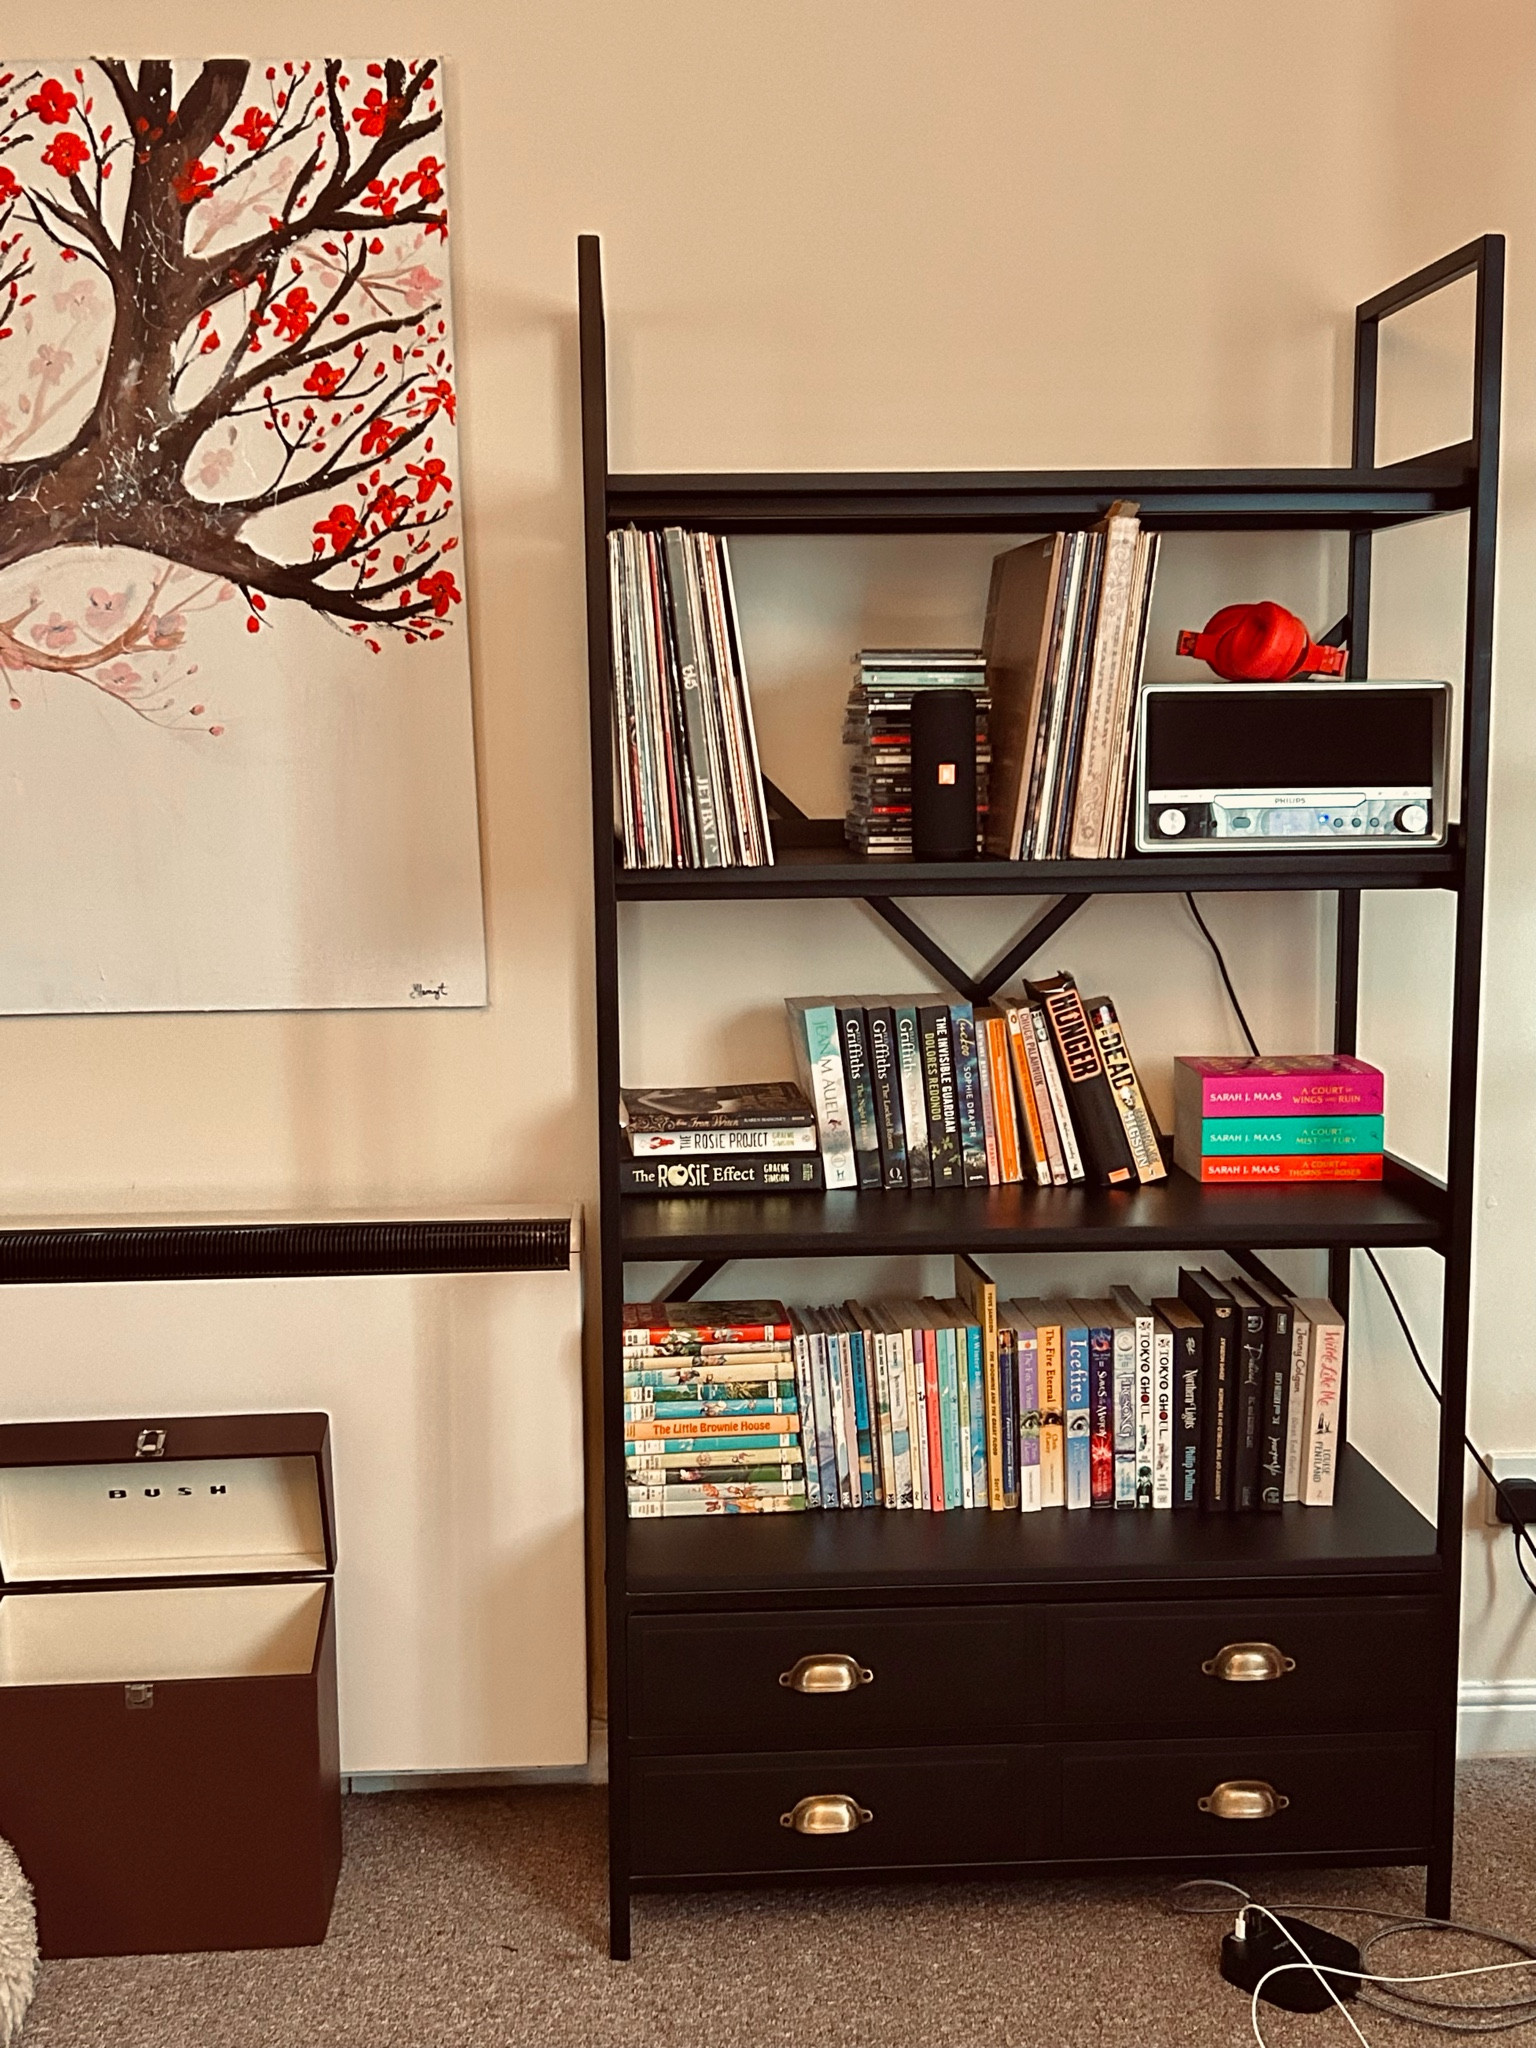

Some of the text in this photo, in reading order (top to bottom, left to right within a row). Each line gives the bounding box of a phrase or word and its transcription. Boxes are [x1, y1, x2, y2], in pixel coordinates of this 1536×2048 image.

[1086, 693, 1102, 777] WILLIAMS
[812, 1019, 832, 1056] JEAN
[846, 1019, 864, 1080] Griffiths
[873, 1019, 890, 1080] Griffiths
[900, 1018, 917, 1079] Griffiths
[1019, 1013, 1033, 1041] CHUCK
[1026, 1042, 1043, 1087] PALAHNIUK
[1049, 992, 1099, 1079] HUNGER
[819, 1057, 833, 1074] M
[936, 1017, 957, 1134] THE INVISIBLE GUARDIAN
[1099, 1032, 1135, 1091] DEAD
[856, 1083, 865, 1098] The
[924, 1032, 942, 1121] DOLORES REDONDO
[956, 1018, 977, 1138] Cuckoo SOPHIE DRAPER
[821, 1080, 840, 1119] AUEL
[1210, 1093, 1242, 1101] SARAH
[1253, 1092, 1282, 1101] MAAS
[1311, 1086, 1343, 1095] COURT
[1292, 1095, 1361, 1104] WINGS RUIN
[857, 1099, 868, 1119] Night
[881, 1083, 895, 1150] The Locked Room
[680, 1135, 691, 1150] THE
[730, 1132, 768, 1149] PROJECT
[1210, 1134, 1242, 1142] SARAH
[1253, 1133, 1282, 1142] MAAS
[1296, 1136, 1358, 1144] MIST FURY
[633, 1169, 655, 1183] The
[713, 1166, 755, 1182] Effect
[763, 1163, 789, 1173] GRAEME
[1208, 1165, 1240, 1174] SARAH
[1251, 1164, 1280, 1173] MAAS
[1311, 1160, 1340, 1168] COURT
[1289, 1167, 1361, 1177] THORNS ROSES
[973, 1333, 981, 1341] A
[1294, 1328, 1307, 1357] Jenny
[973, 1341, 982, 1370] Winter
[1024, 1352, 1034, 1367] The
[1045, 1329, 1056, 1403] The Fire Eternal
[1317, 1331, 1341, 1406] Wilde Like Me
[974, 1371, 982, 1390] Book
[1070, 1339, 1088, 1403] Icefire
[1139, 1332, 1151, 1424] TOKYO GHOUL
[1182, 1368, 1199, 1403] Northern
[1292, 1359, 1306, 1393] Colgan
[986, 1292, 994, 1308] TOVE
[994, 1493, 1000, 1502] Of
[1024, 1384, 1034, 1409] Within
[1158, 1349, 1170, 1440] TOKYO GHOUL
[1217, 1387, 1225, 1411] WOMEN
[653, 1421, 771, 1435] The Little Brownie House
[1181, 1403, 1198, 1430] Lights
[1051, 1433, 1059, 1451] Chris
[1181, 1445, 1196, 1501] Philip Pullman
[1312, 1441, 1324, 1483] PENTLAND
[1322, 1448, 1332, 1476] LOUISE
[109, 1485, 226, 1499] BUSH
